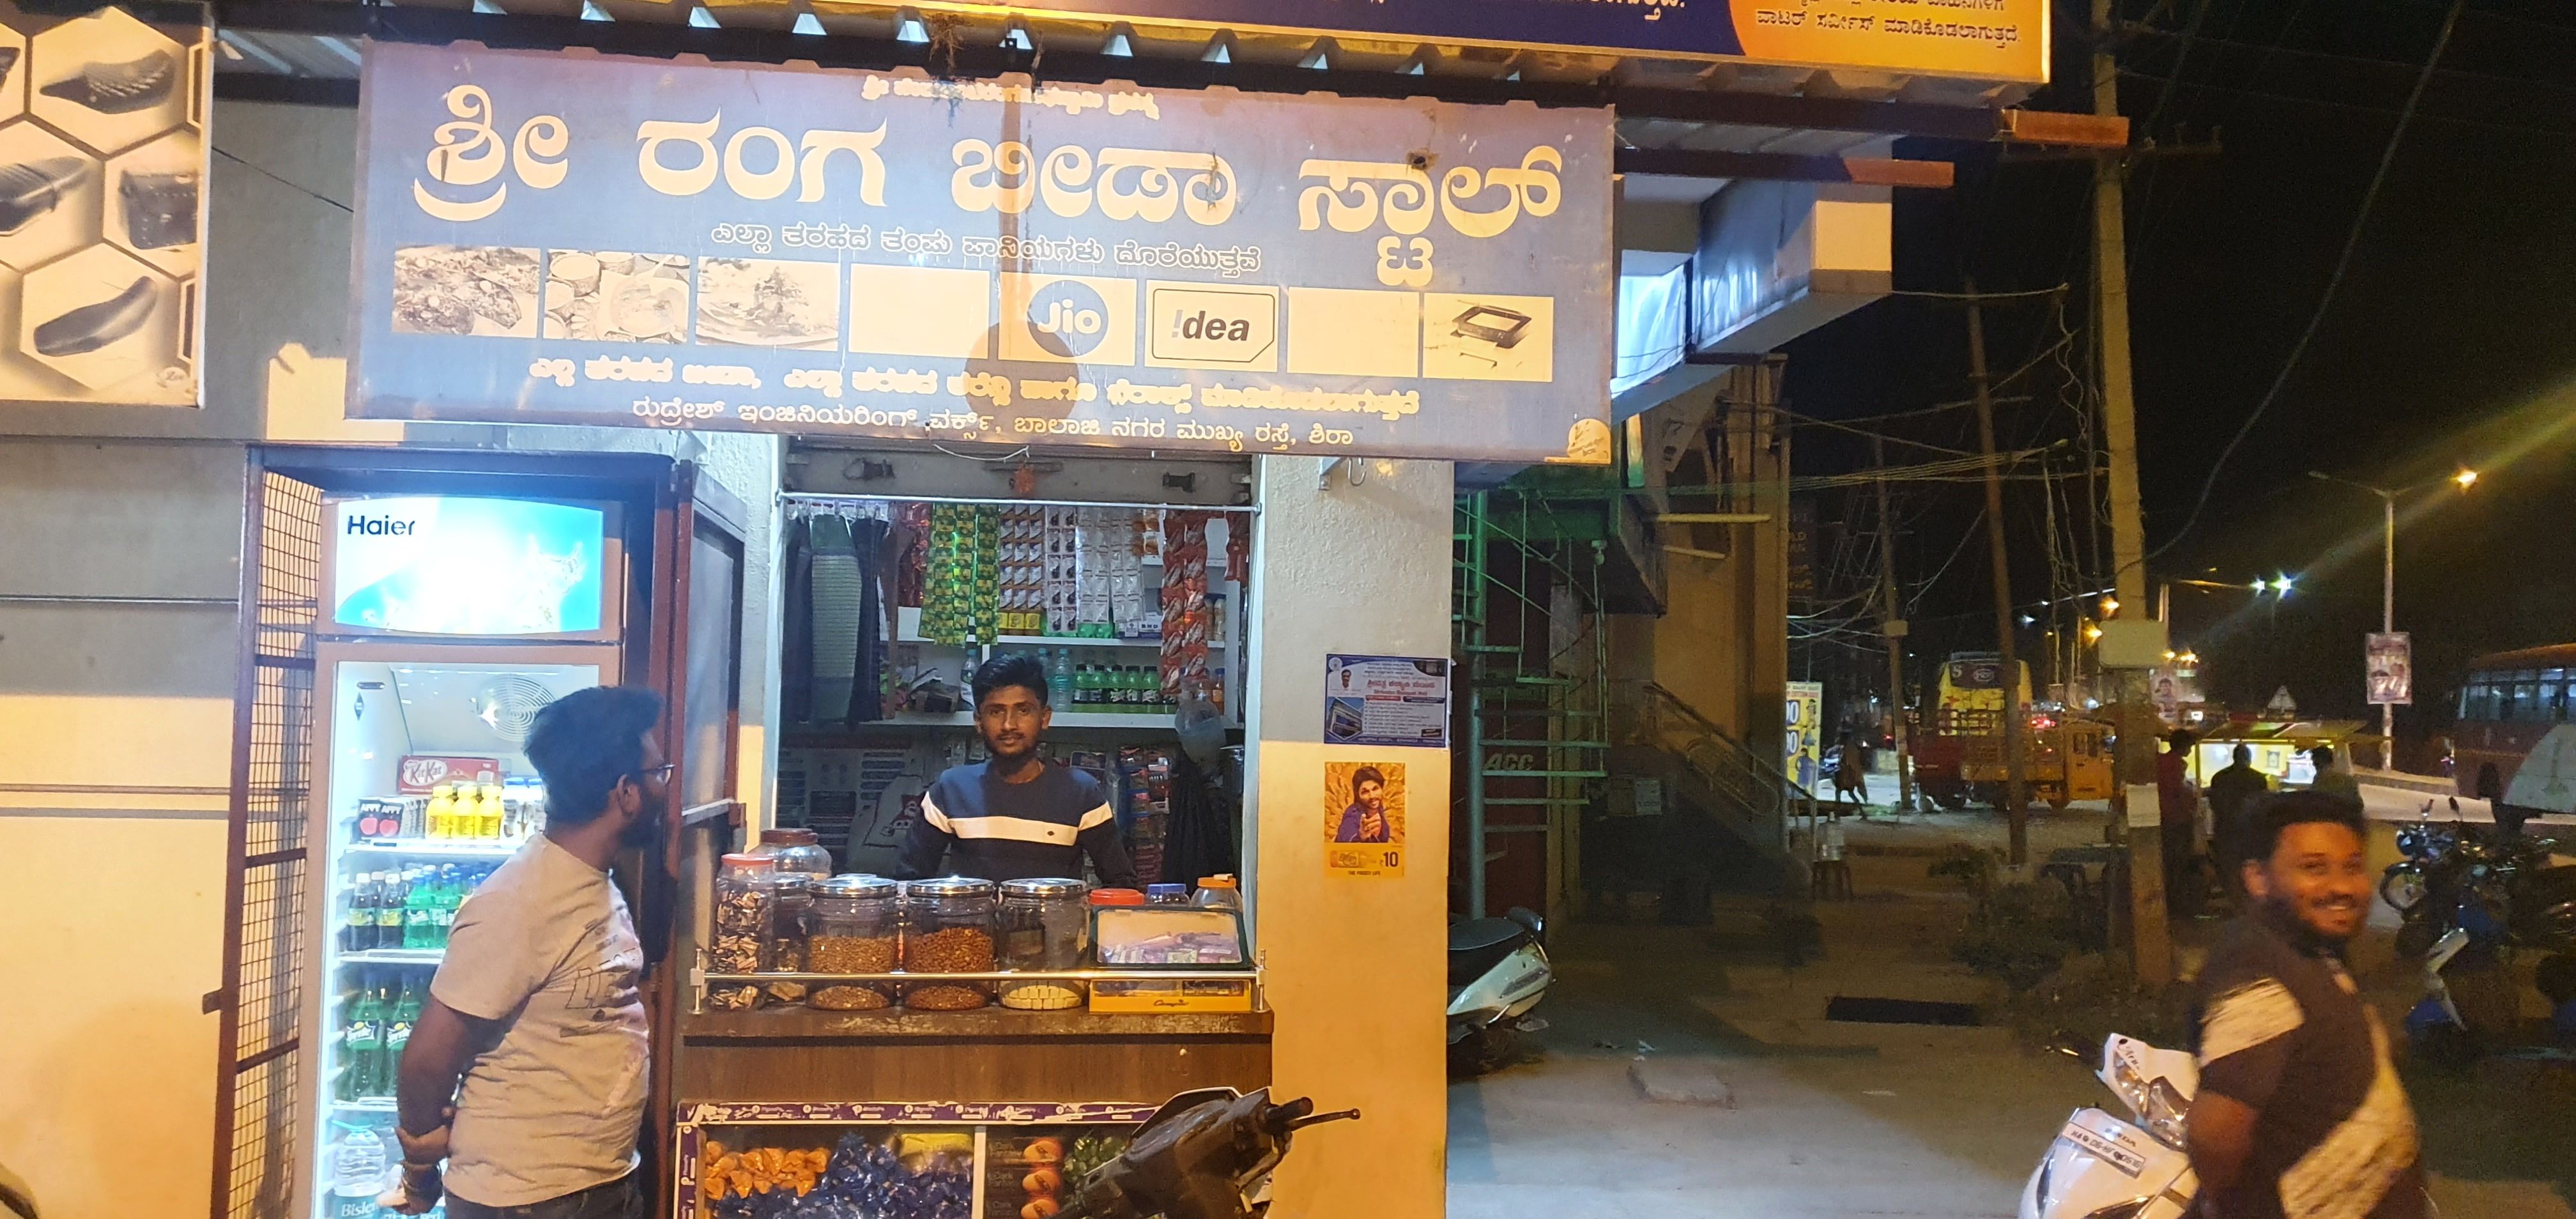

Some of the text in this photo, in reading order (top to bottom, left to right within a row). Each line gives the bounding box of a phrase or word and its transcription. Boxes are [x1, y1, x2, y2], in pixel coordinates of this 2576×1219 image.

[413, 84, 1562, 286] ಶ್ರೀ ರಂಗ ಬೀಡಾ ಸ್ಟಾಲ್
[711, 222, 772, 254] ಎಲ್ಲಾ
[782, 221, 871, 249] ತರಹದ
[881, 226, 953, 256] ತಂಪು
[1114, 239, 1262, 278] ದೊರೆಯುತ್ತವೆ
[1037, 299, 1102, 334] Jio
[632, 395, 726, 426] ರುದ್ರೇಶ್
[738, 402, 918, 427] ಇಂಜಿನಿಯರಿಂಗ್
[1014, 415, 1101, 436] ಬಾಲಾಜಿ
[1112, 416, 1165, 438] ನಗರ
[1176, 419, 1244, 452] ಮುಖ್ಯ
[1308, 422, 1354, 445] ಶಿರಾ
[347, 515, 415, 535] Haier
